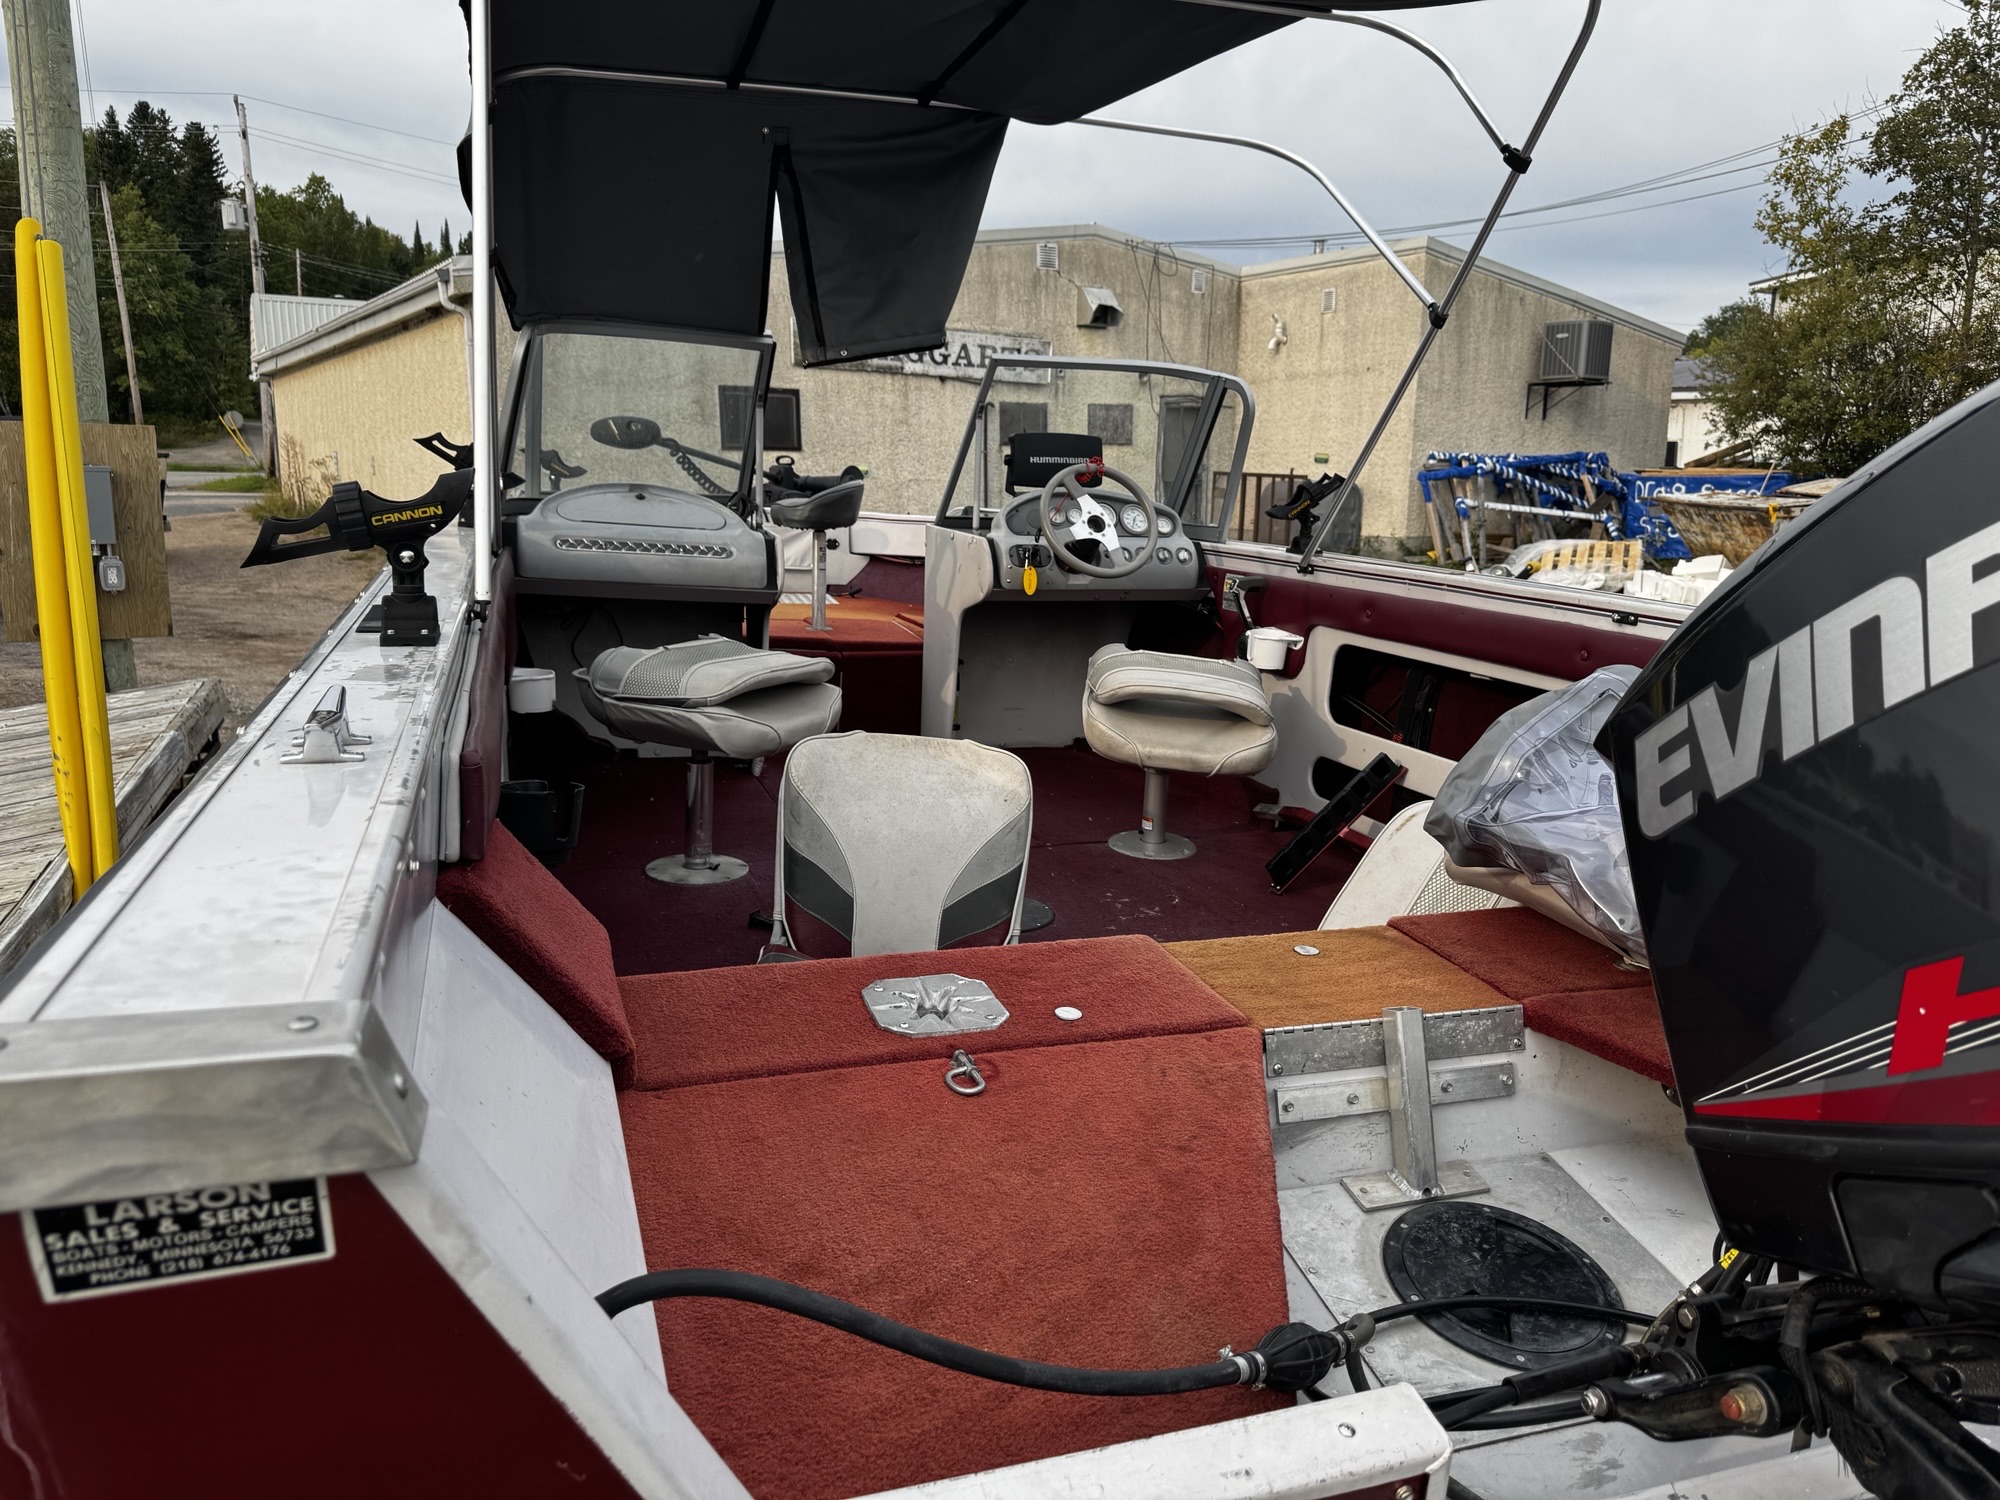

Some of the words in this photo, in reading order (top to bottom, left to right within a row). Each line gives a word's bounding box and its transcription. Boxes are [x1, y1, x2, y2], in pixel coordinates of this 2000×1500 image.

[1029, 456, 1090, 464] HUMMINBIRD
[371, 504, 443, 527] CANNON
[1288, 499, 1311, 518] CANNON
[84, 1182, 272, 1227] LARSON
[45, 1221, 140, 1251] SALES
[158, 1216, 181, 1234] &
[199, 1196, 315, 1228] SERVICE
[52, 1244, 120, 1265] BOATS
[132, 1228, 213, 1252] MOTORS
[225, 1213, 314, 1238] CAMPERS
[152, 1237, 256, 1262] MINNESOTA
[90, 1264, 151, 1285] PHONE
[160, 1259, 204, 1276] (218)
